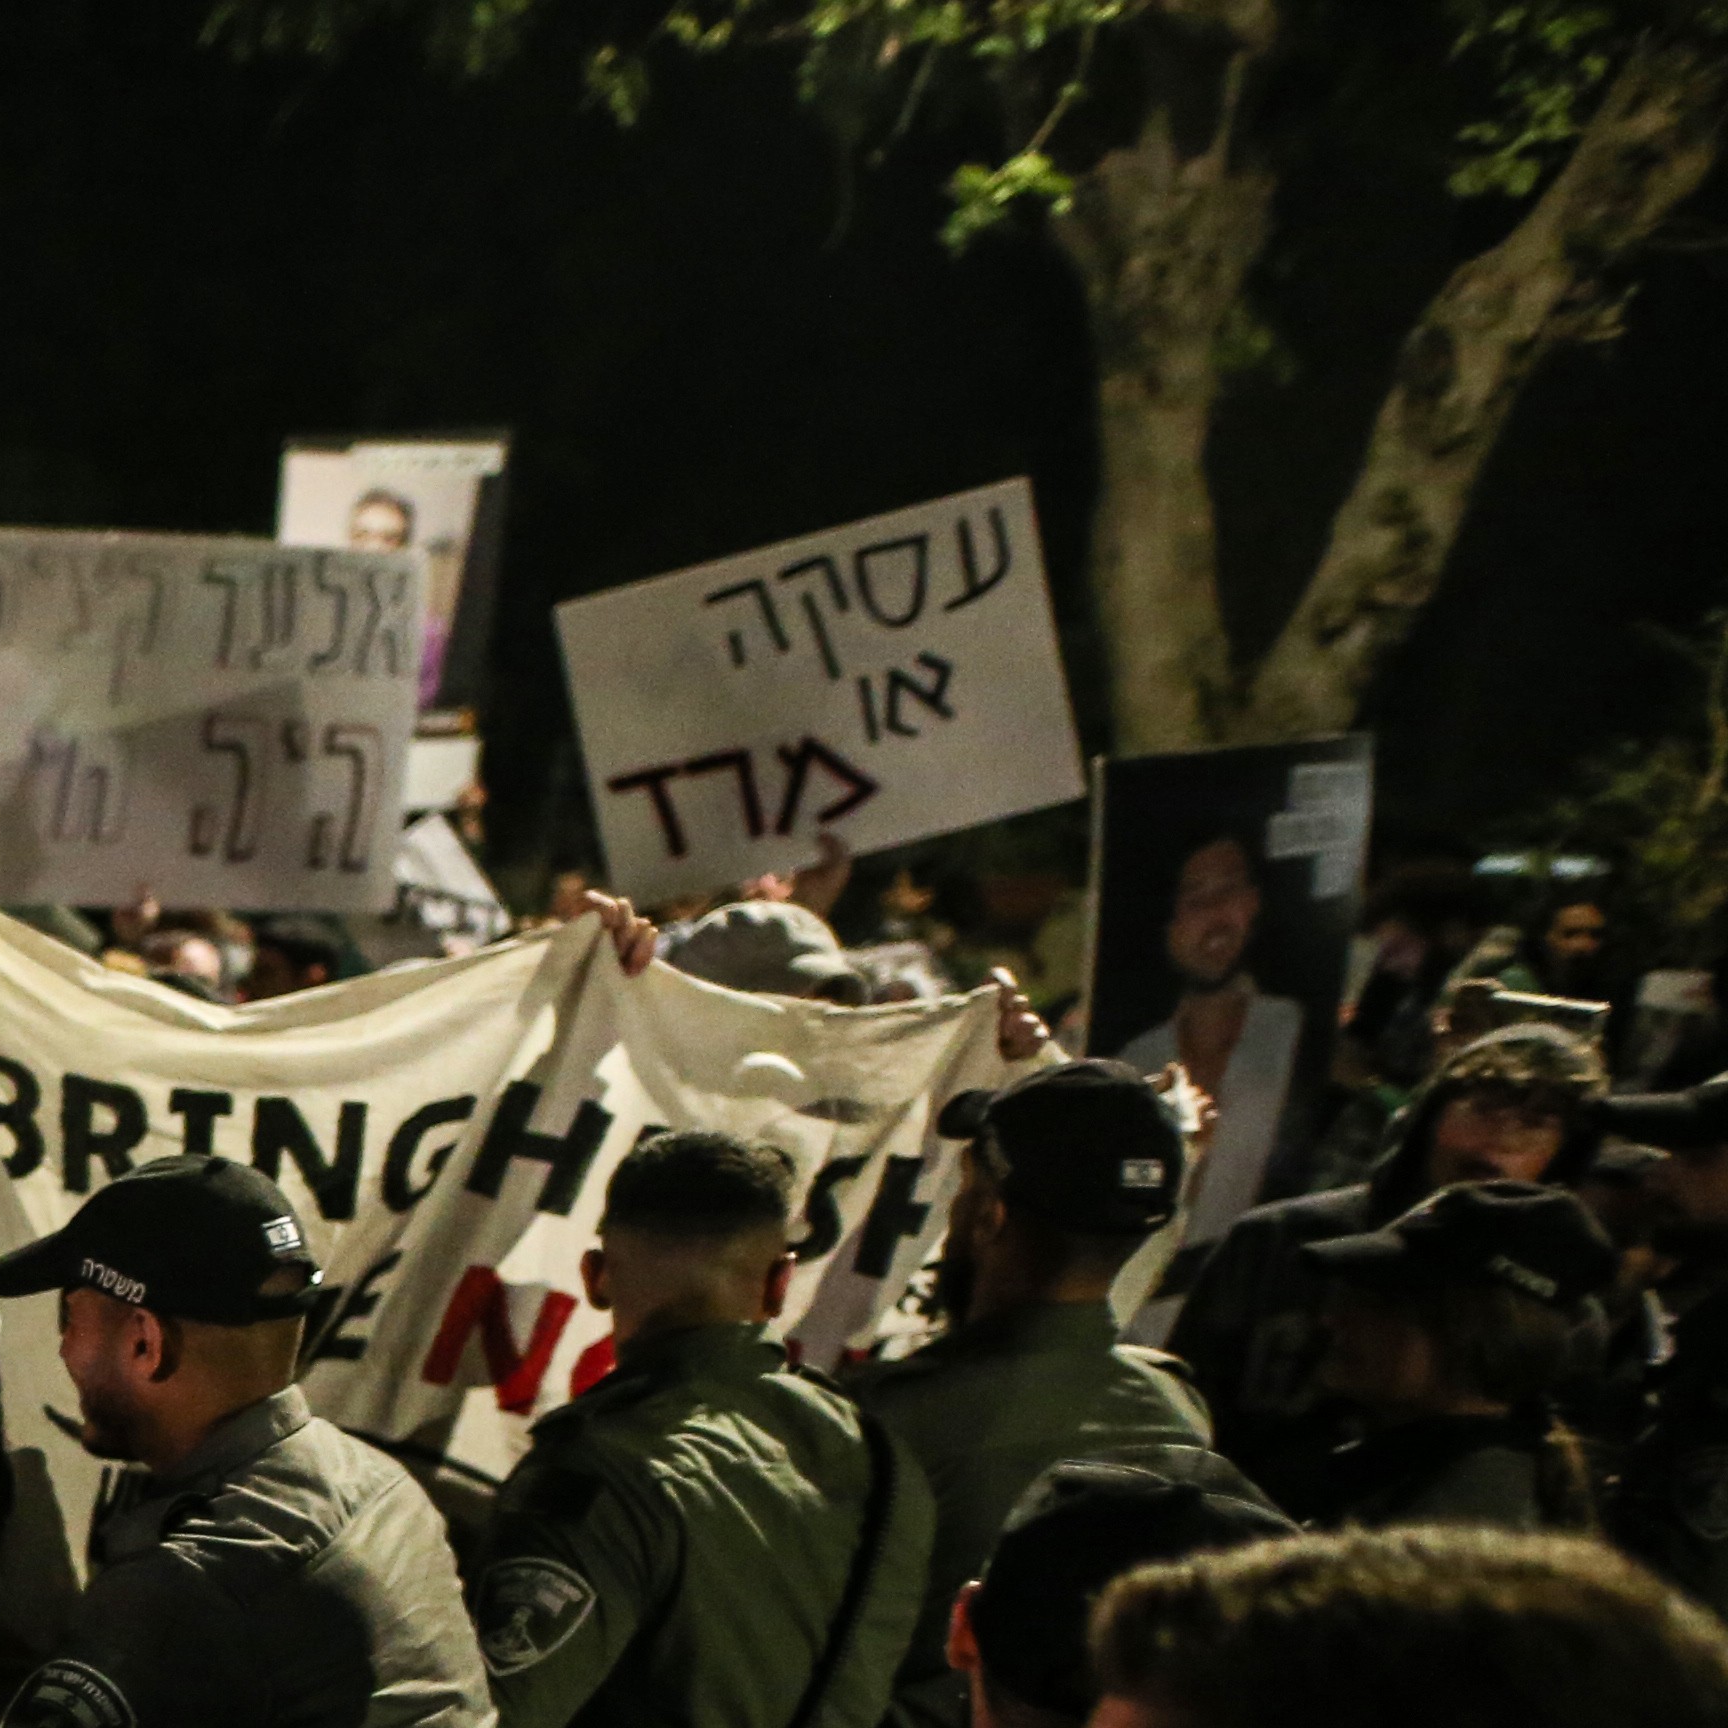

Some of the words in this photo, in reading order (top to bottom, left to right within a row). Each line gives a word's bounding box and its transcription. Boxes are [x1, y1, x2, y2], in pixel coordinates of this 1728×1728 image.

[703, 506, 1012, 682] עסקה
[857, 648, 957, 745] או
[607, 735, 880, 860] מרד
[81, 1257, 148, 1305] משטרה
